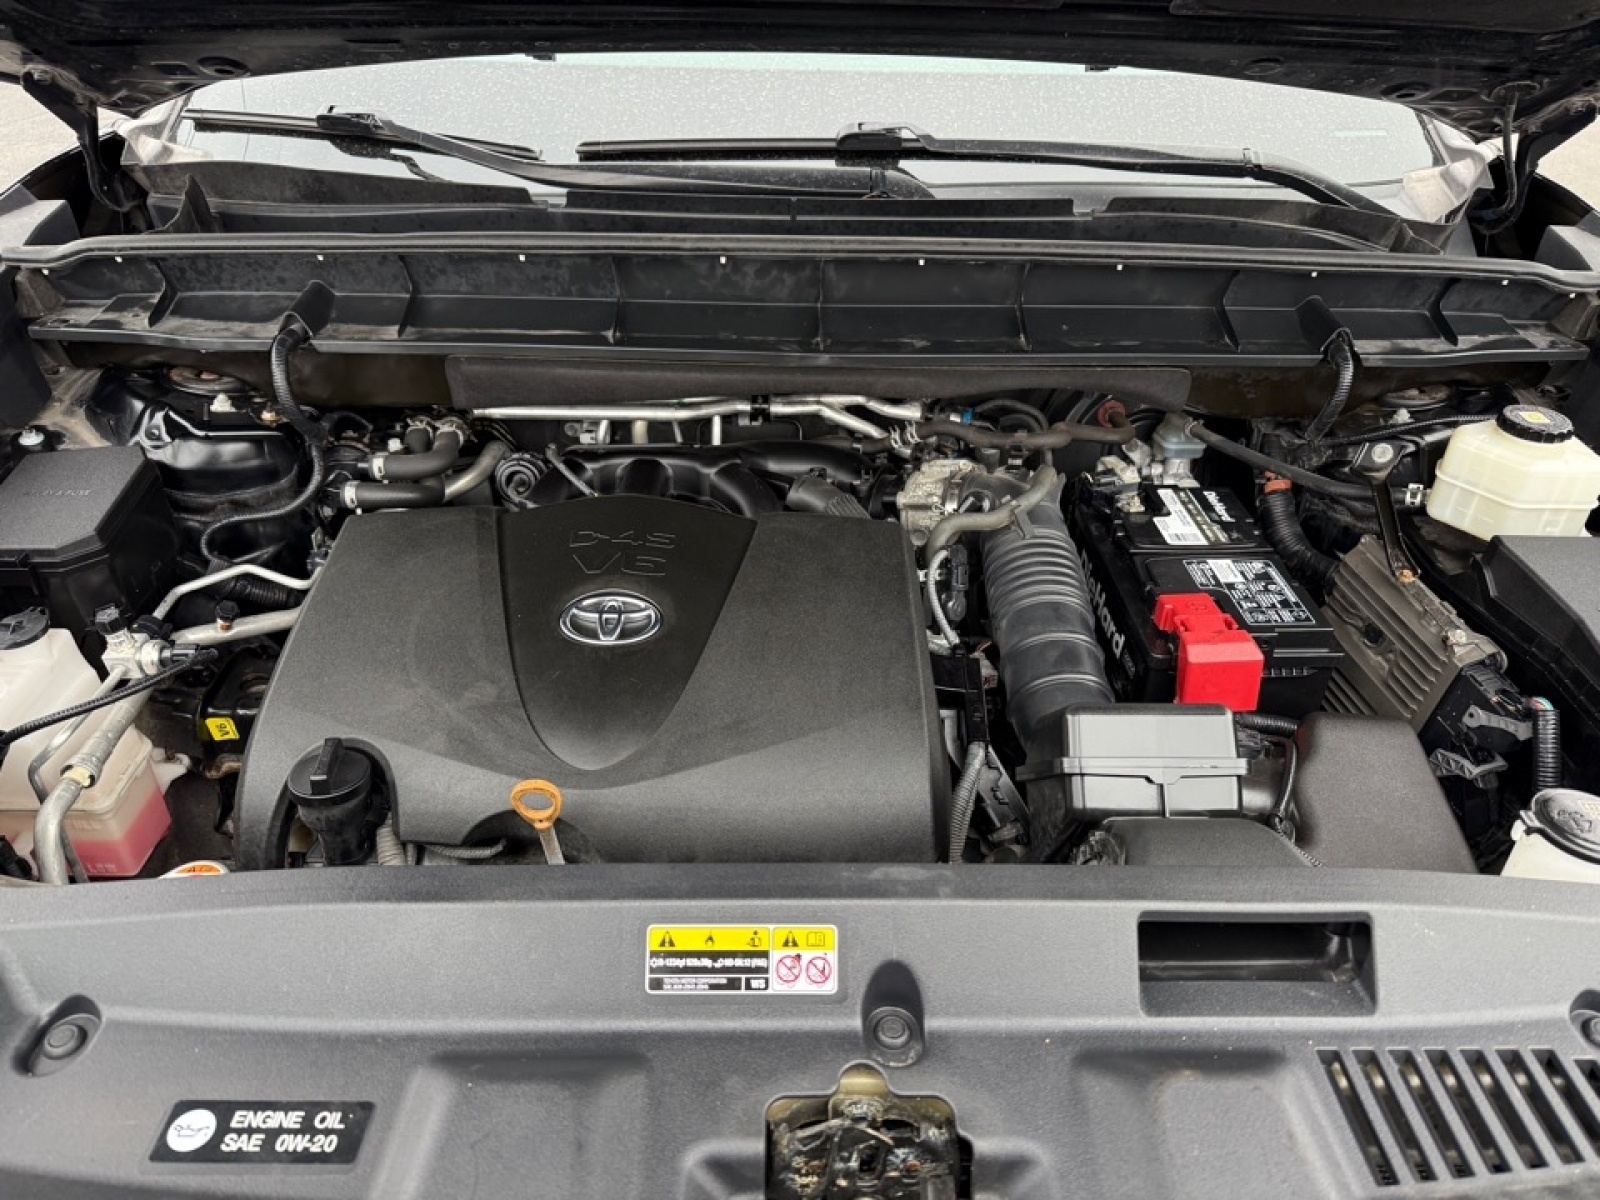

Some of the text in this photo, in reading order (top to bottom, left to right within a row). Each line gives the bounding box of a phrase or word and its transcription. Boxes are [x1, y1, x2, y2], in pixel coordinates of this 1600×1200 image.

[572, 551, 668, 576] V6
[229, 1109, 346, 1129] ENGINE OIL
[219, 1133, 339, 1153] SAE 0W-20
